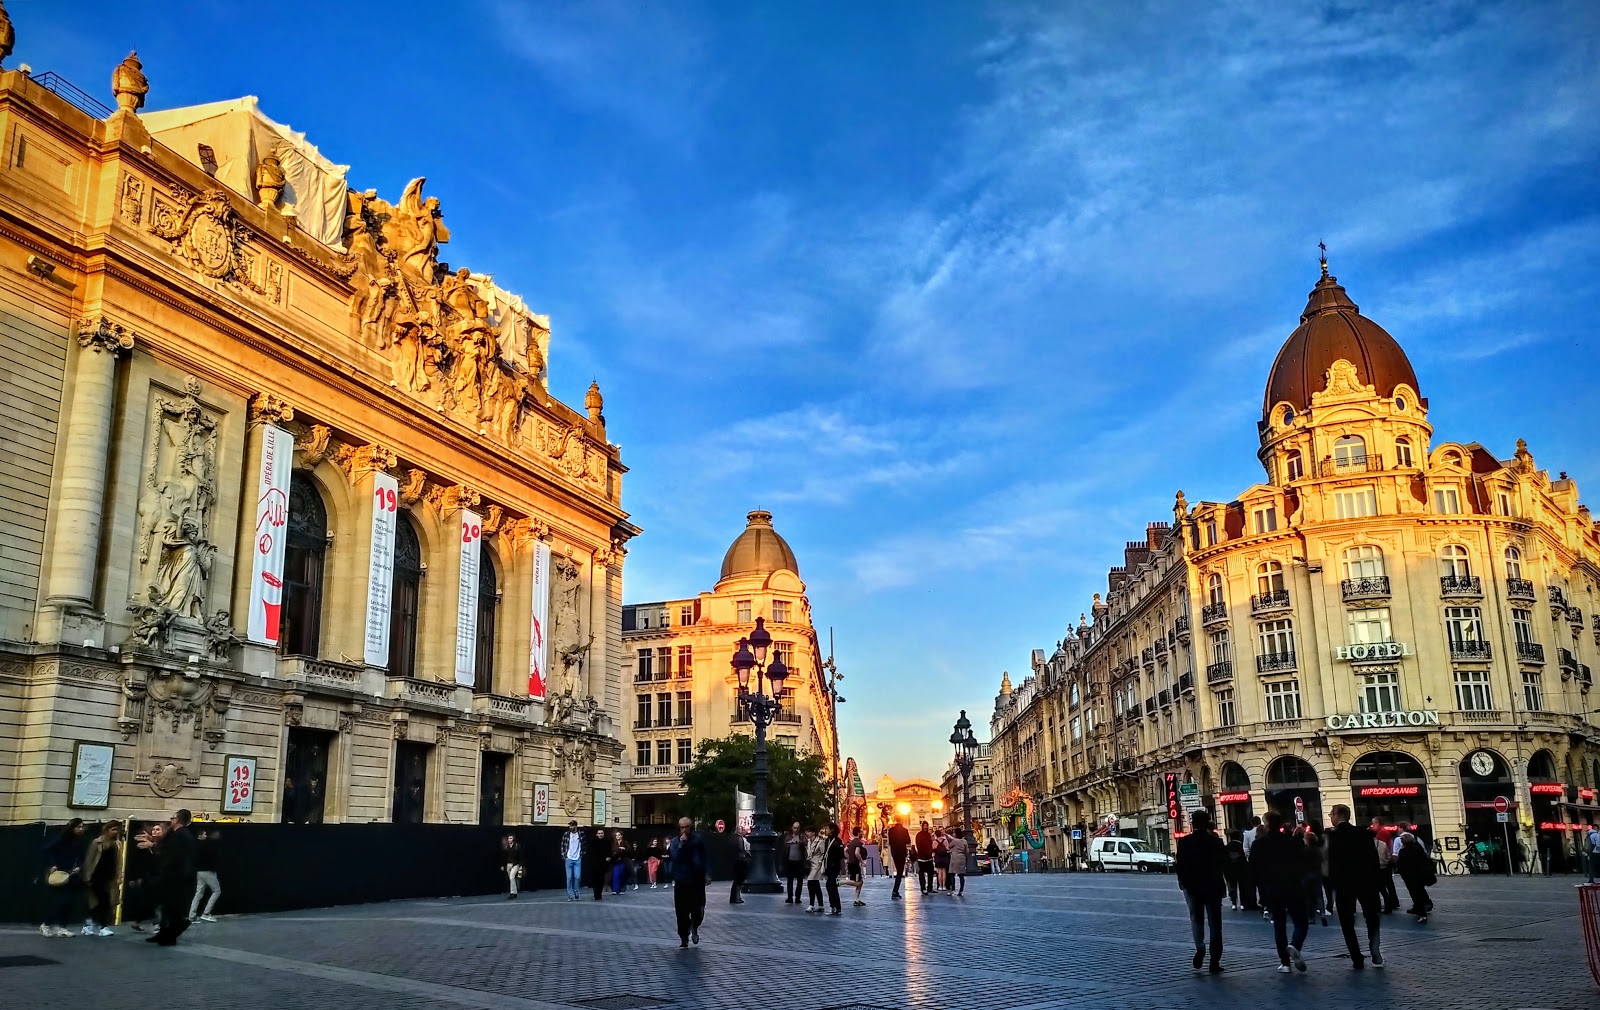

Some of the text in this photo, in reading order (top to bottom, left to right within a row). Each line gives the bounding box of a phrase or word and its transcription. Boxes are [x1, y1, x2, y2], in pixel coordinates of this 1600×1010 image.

[264, 429, 276, 485] OPÉRA DE LILLE
[375, 486, 397, 512] 19
[462, 522, 480, 543] 20
[1335, 642, 1415, 660] HOTEL
[1327, 710, 1440, 730] CARLTON
[233, 765, 250, 781] 19
[231, 788, 249, 804] 20
[537, 789, 546, 801] 19
[1166, 773, 1178, 818] HIPPO
[536, 805, 546, 817] 20
